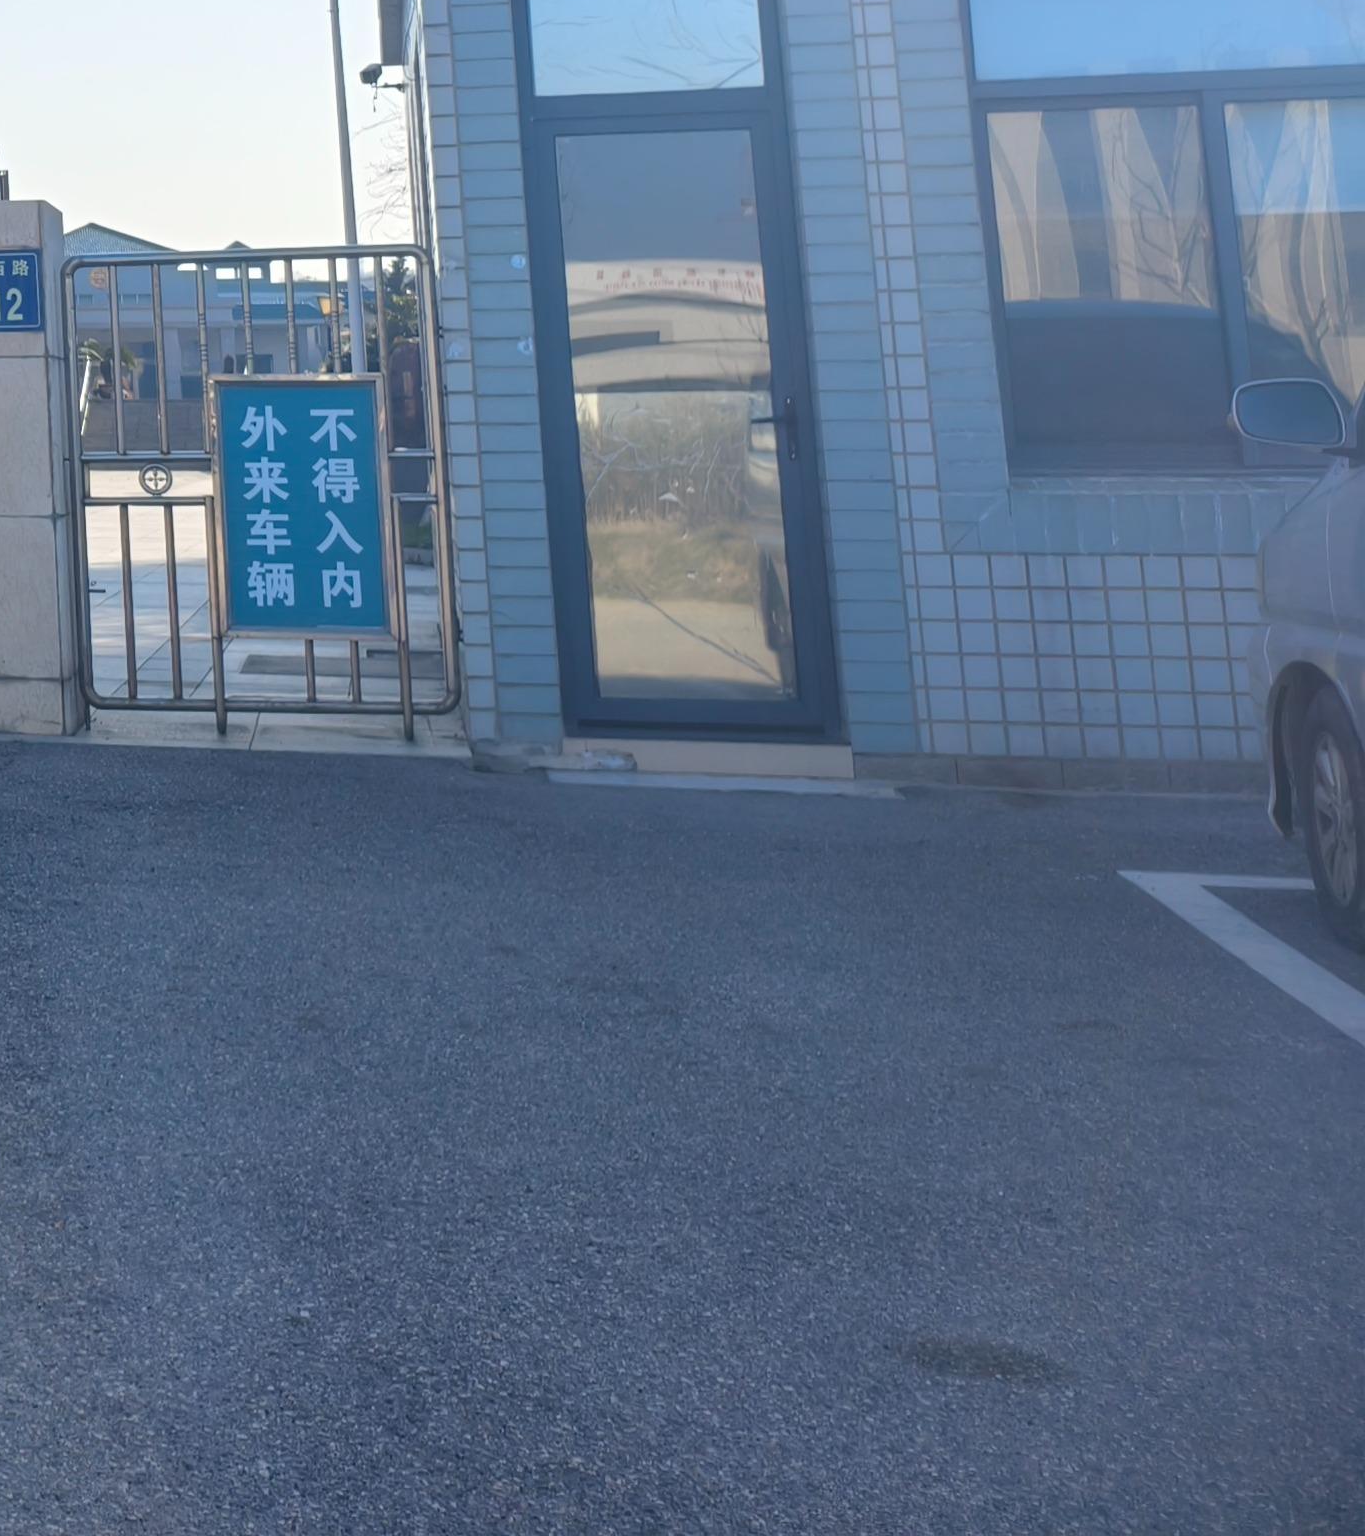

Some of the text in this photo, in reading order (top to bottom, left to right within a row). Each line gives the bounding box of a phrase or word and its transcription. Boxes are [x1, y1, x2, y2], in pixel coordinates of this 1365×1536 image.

[240, 405, 295, 608] 外来车辆
[309, 408, 364, 608] 不得入内
